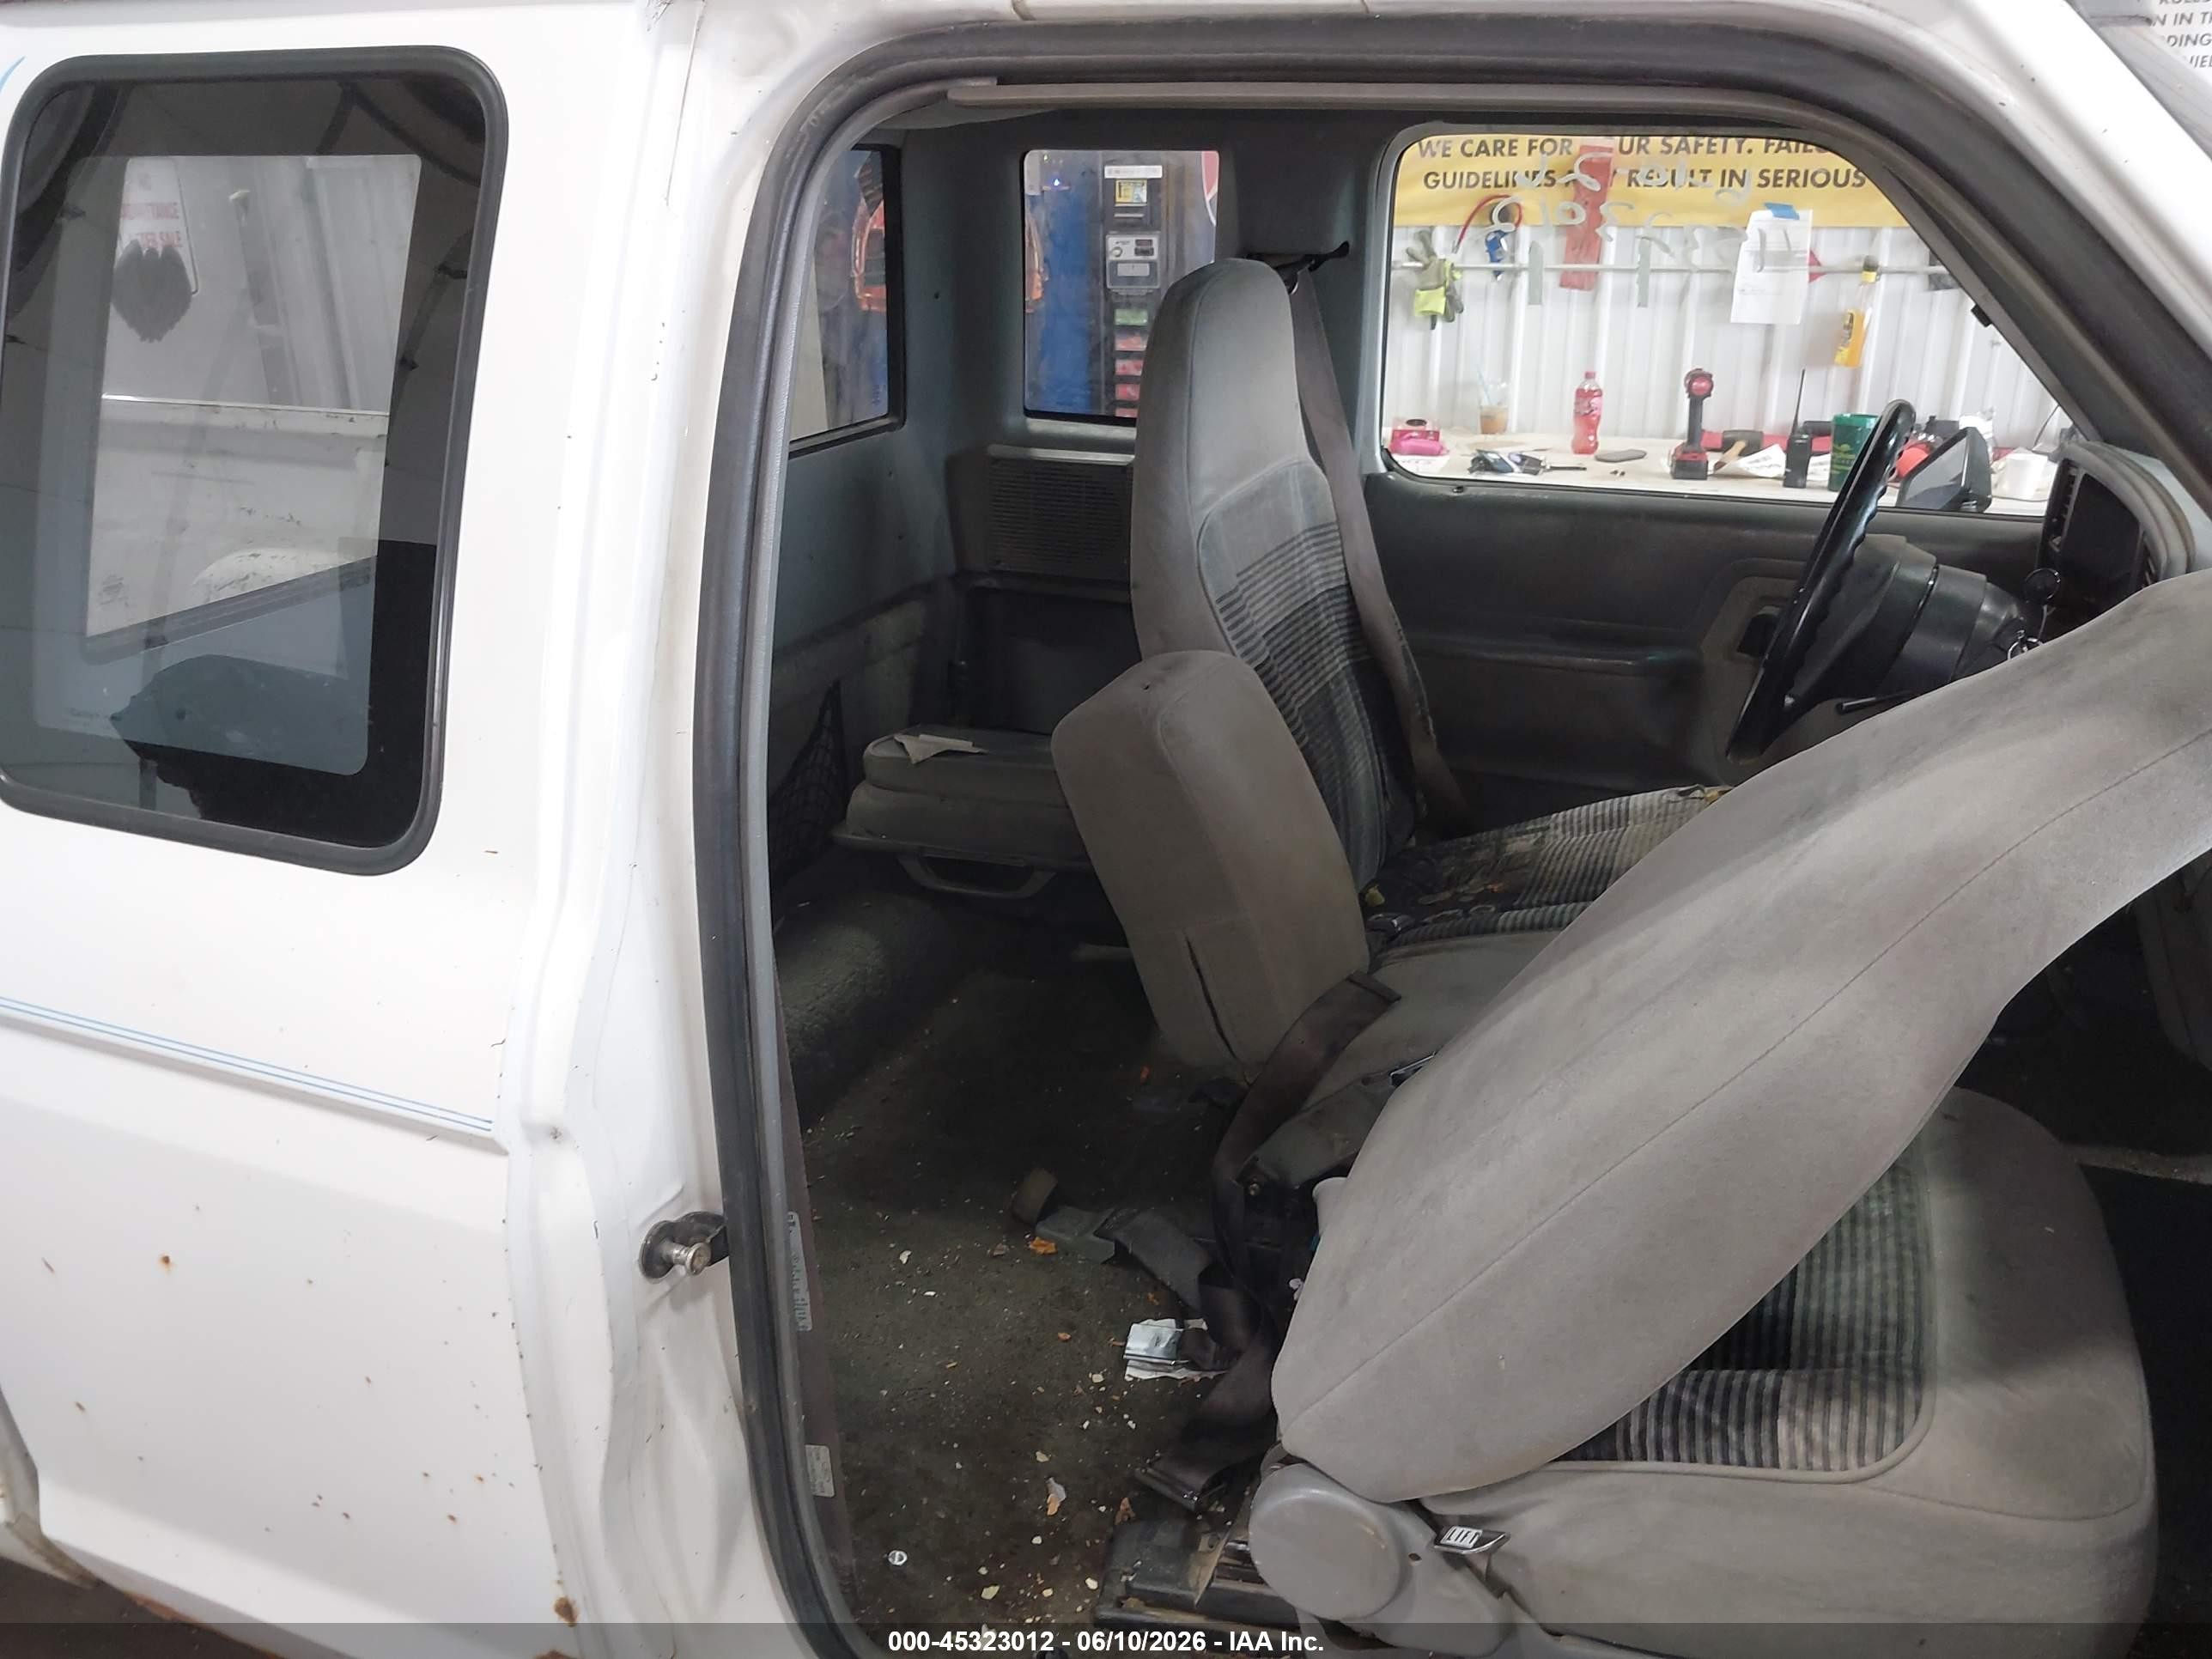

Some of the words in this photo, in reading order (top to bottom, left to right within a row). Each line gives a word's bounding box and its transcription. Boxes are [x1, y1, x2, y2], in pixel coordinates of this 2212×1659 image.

[2173, 12, 2194, 26] IN
[1418, 140, 1452, 158] WE
[1460, 139, 1519, 158] CARE
[1528, 137, 1573, 156] FOR
[1619, 137, 1650, 155] UR
[1660, 137, 1753, 155] SAFETY.
[1720, 168, 1747, 187] IN
[1757, 167, 1867, 188] SERIOUS
[1447, 1528, 1480, 1544] LIFT
